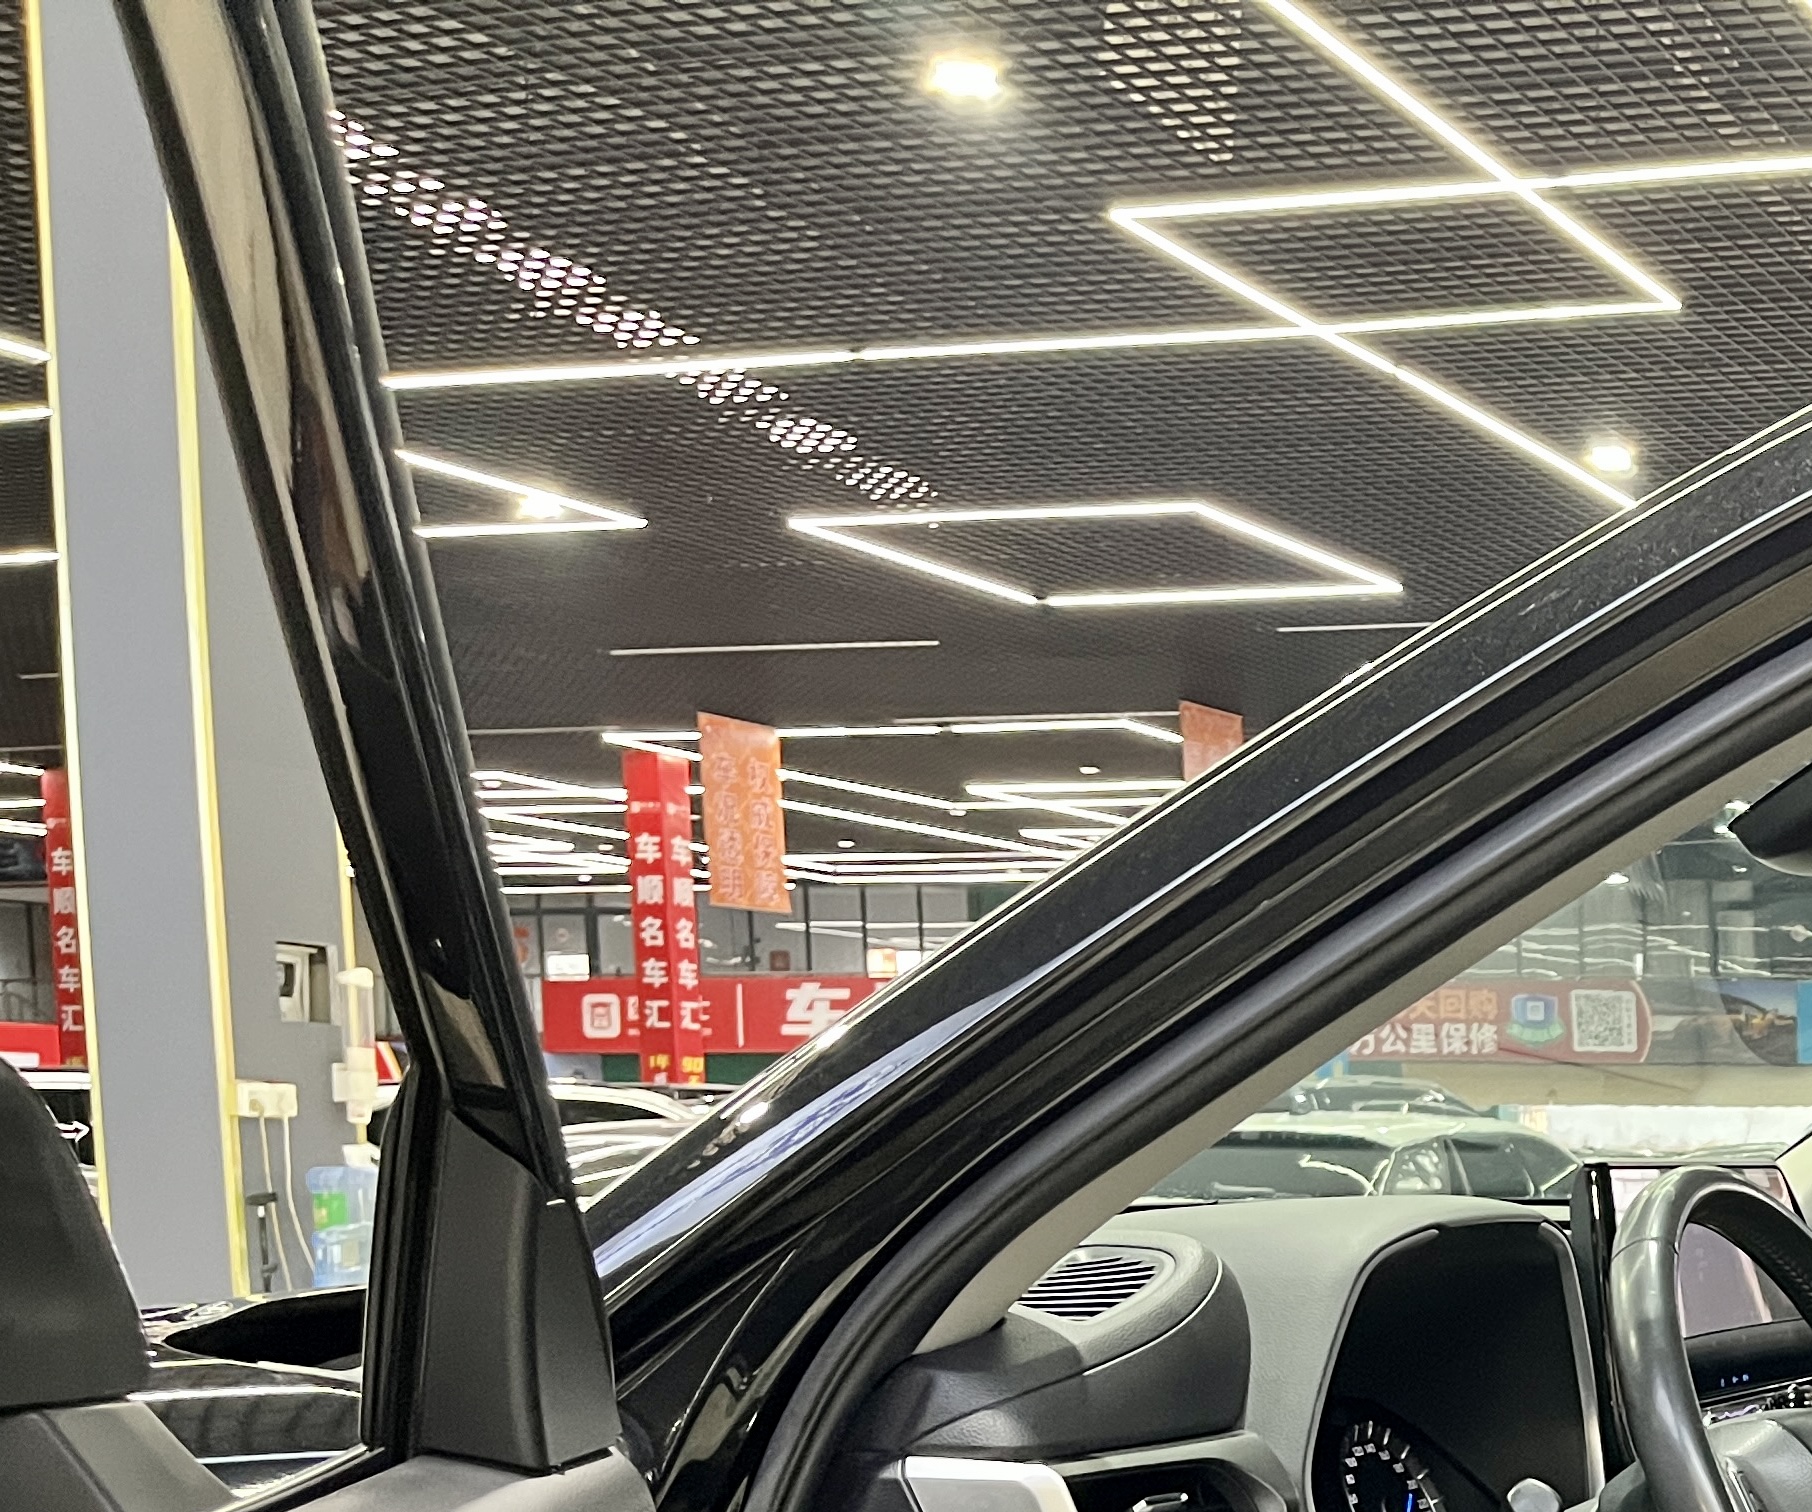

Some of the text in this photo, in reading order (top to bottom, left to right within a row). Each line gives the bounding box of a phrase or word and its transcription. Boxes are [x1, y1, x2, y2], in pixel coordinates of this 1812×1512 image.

[51, 847, 84, 1032] 车顺名车汇
[634, 832, 669, 1029] 车顺名车汇
[671, 835, 702, 1031] 车顺名车汇
